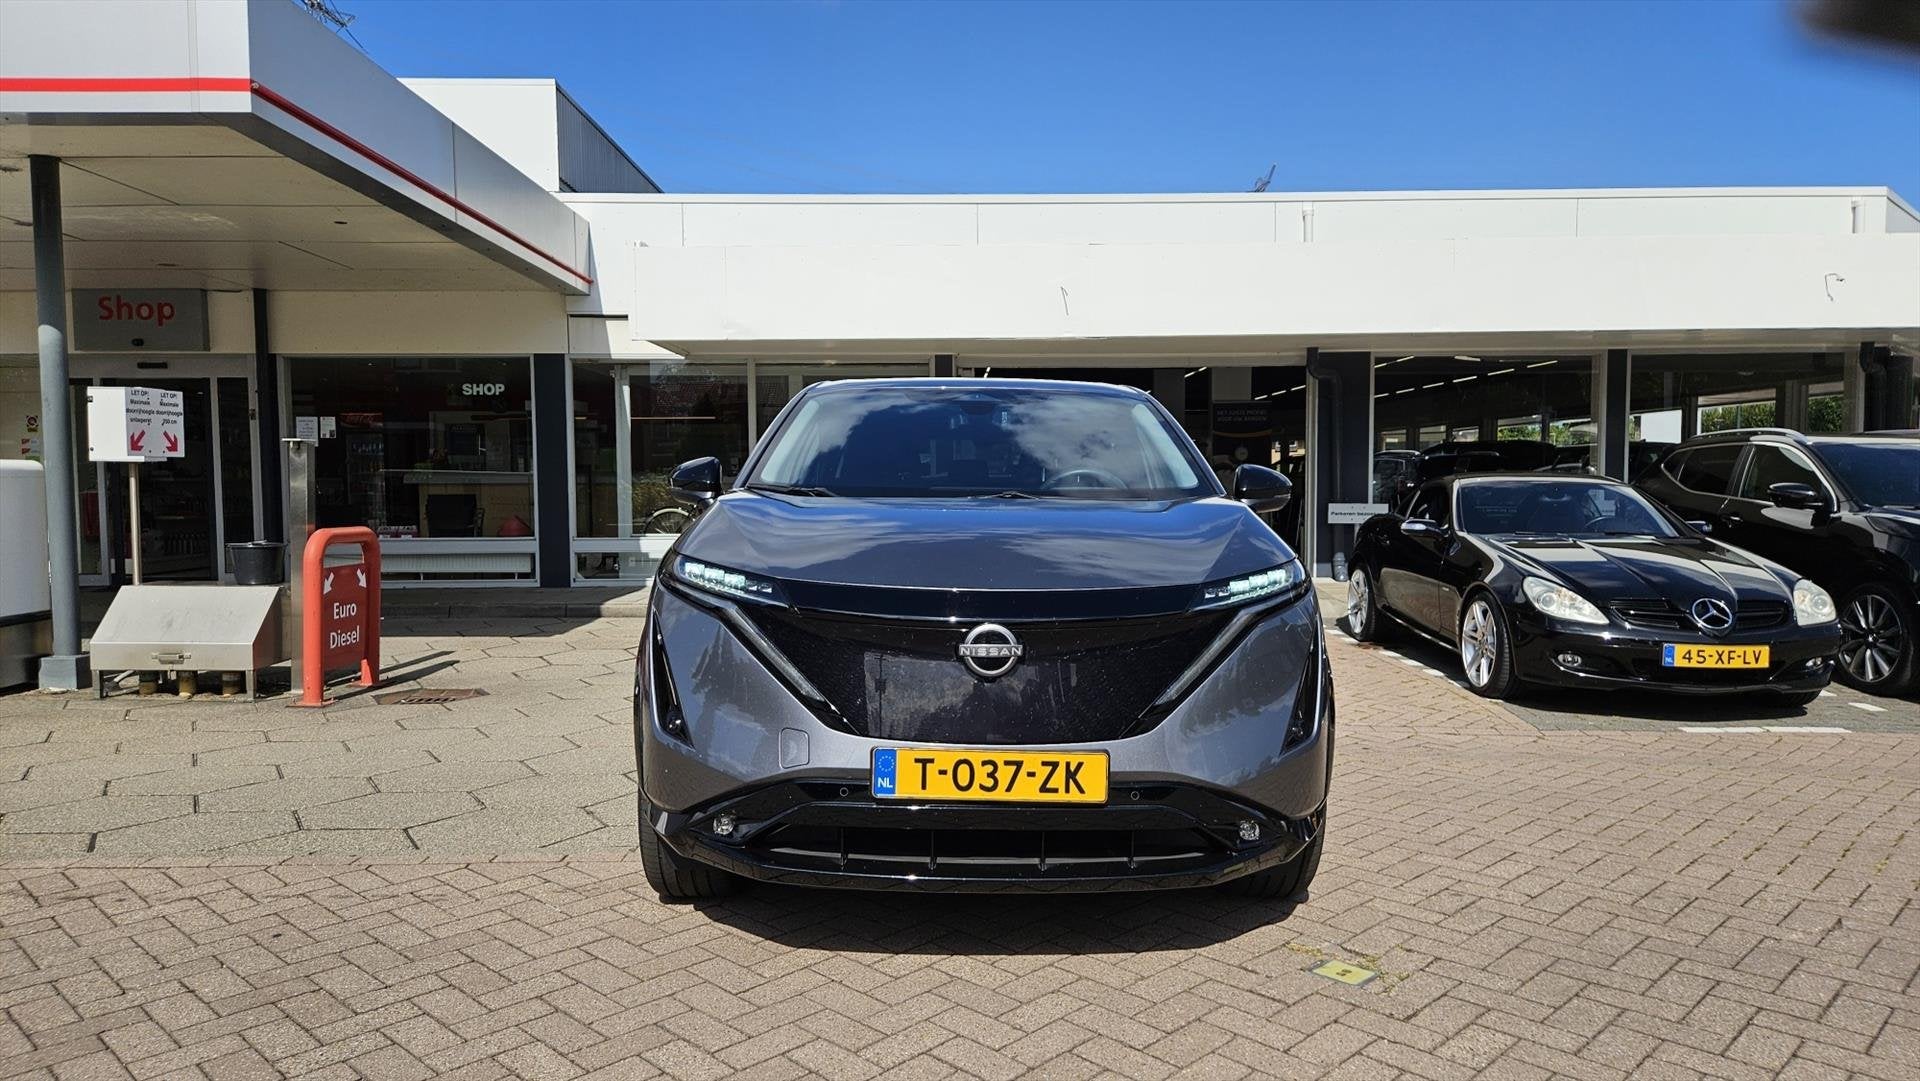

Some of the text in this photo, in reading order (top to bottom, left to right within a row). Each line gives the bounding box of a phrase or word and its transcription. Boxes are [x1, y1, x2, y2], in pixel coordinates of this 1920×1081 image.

[97, 294, 176, 328] Shop
[462, 383, 506, 396] SHOP
[333, 602, 357, 620] Euro
[329, 625, 360, 649] Diesel
[960, 646, 1022, 656] NISSAN
[1681, 649, 1762, 665] 45-XF-LV
[877, 757, 1086, 795] NL T-037-ZK
